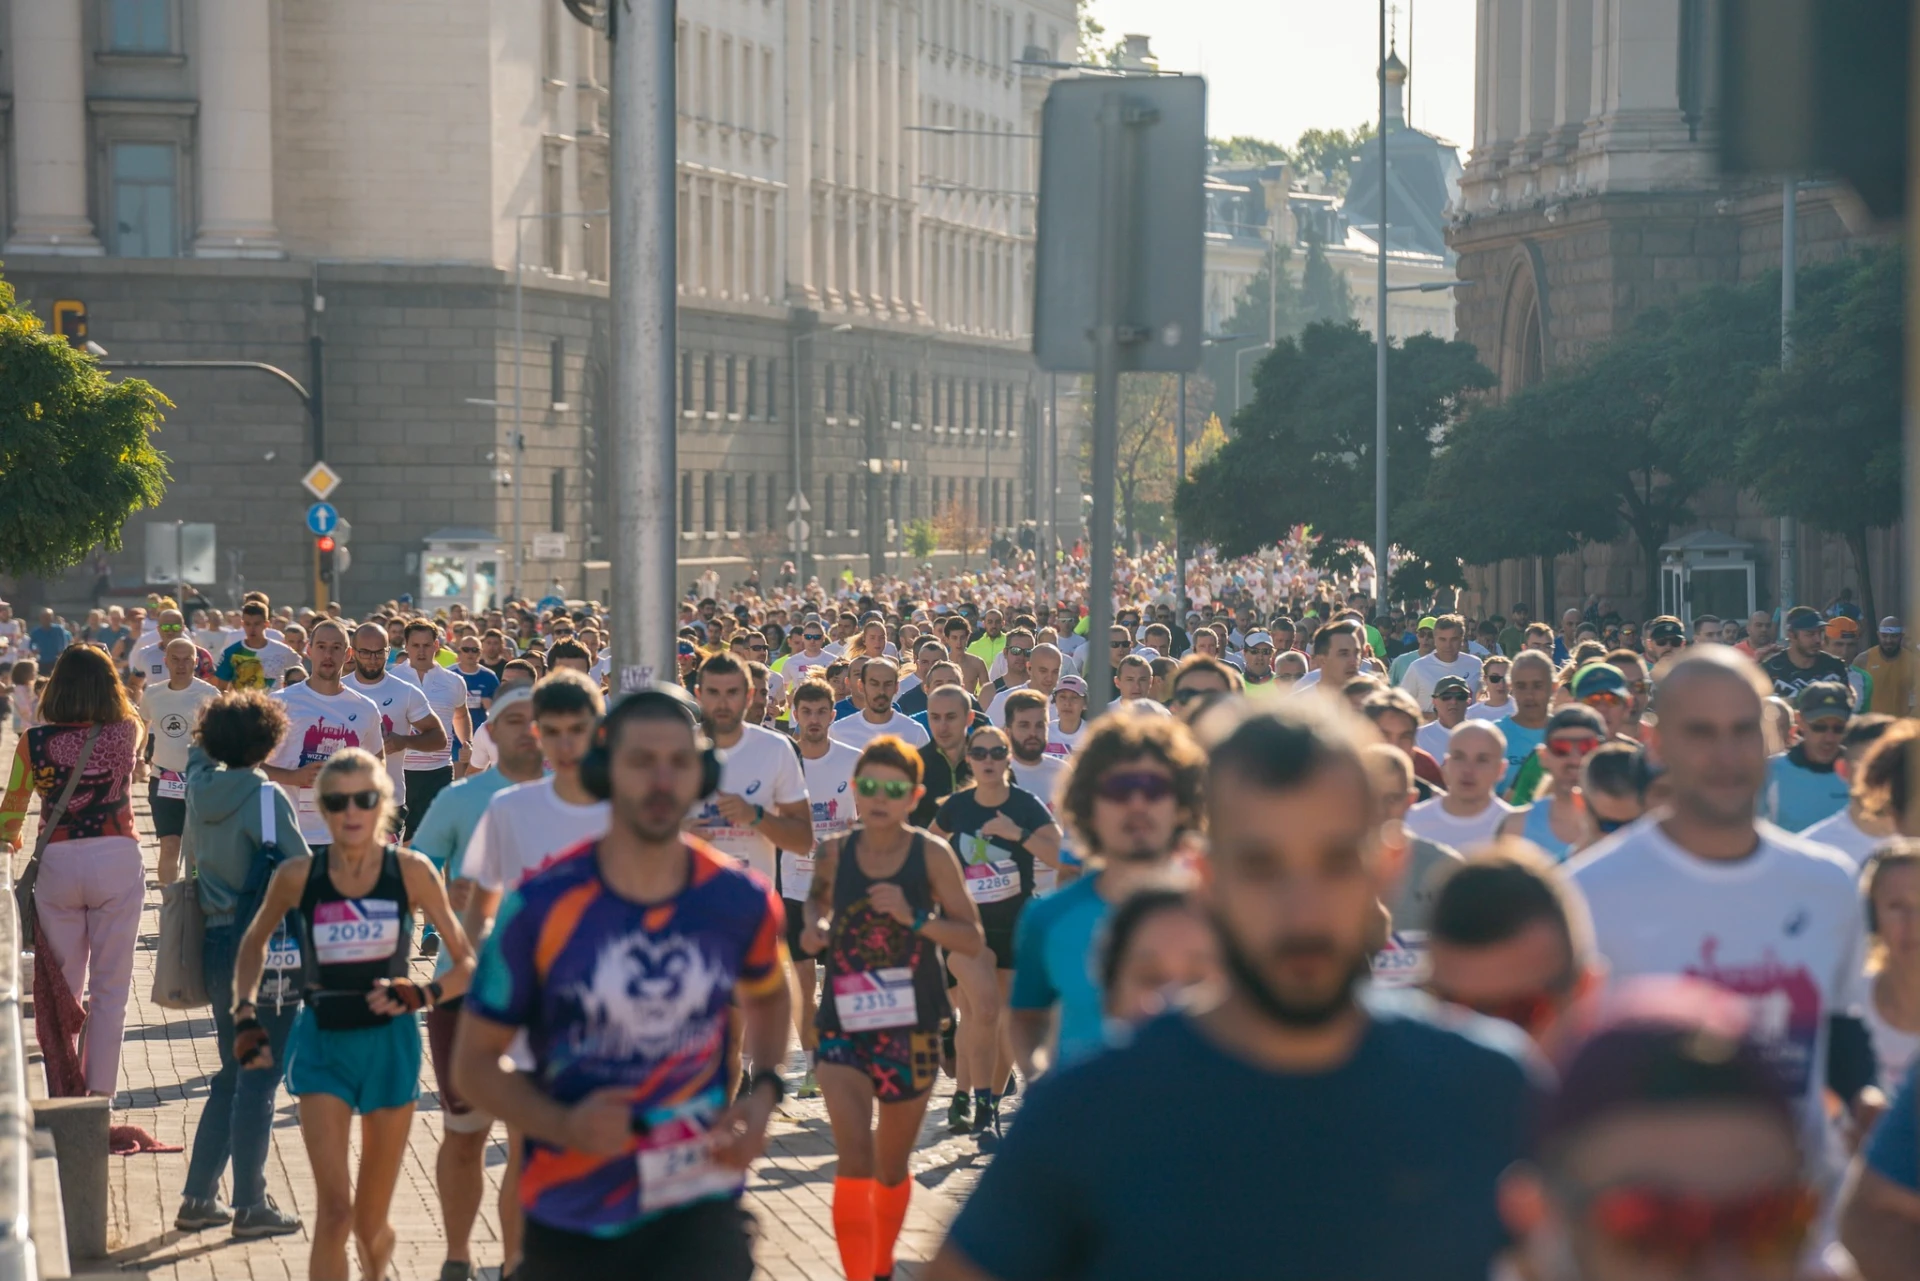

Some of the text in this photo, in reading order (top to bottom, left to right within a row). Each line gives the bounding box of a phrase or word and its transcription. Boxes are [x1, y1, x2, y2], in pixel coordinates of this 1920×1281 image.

[977, 875, 1010, 890] 2286
[328, 923, 384, 942] 2092
[854, 990, 897, 1012] 2315
